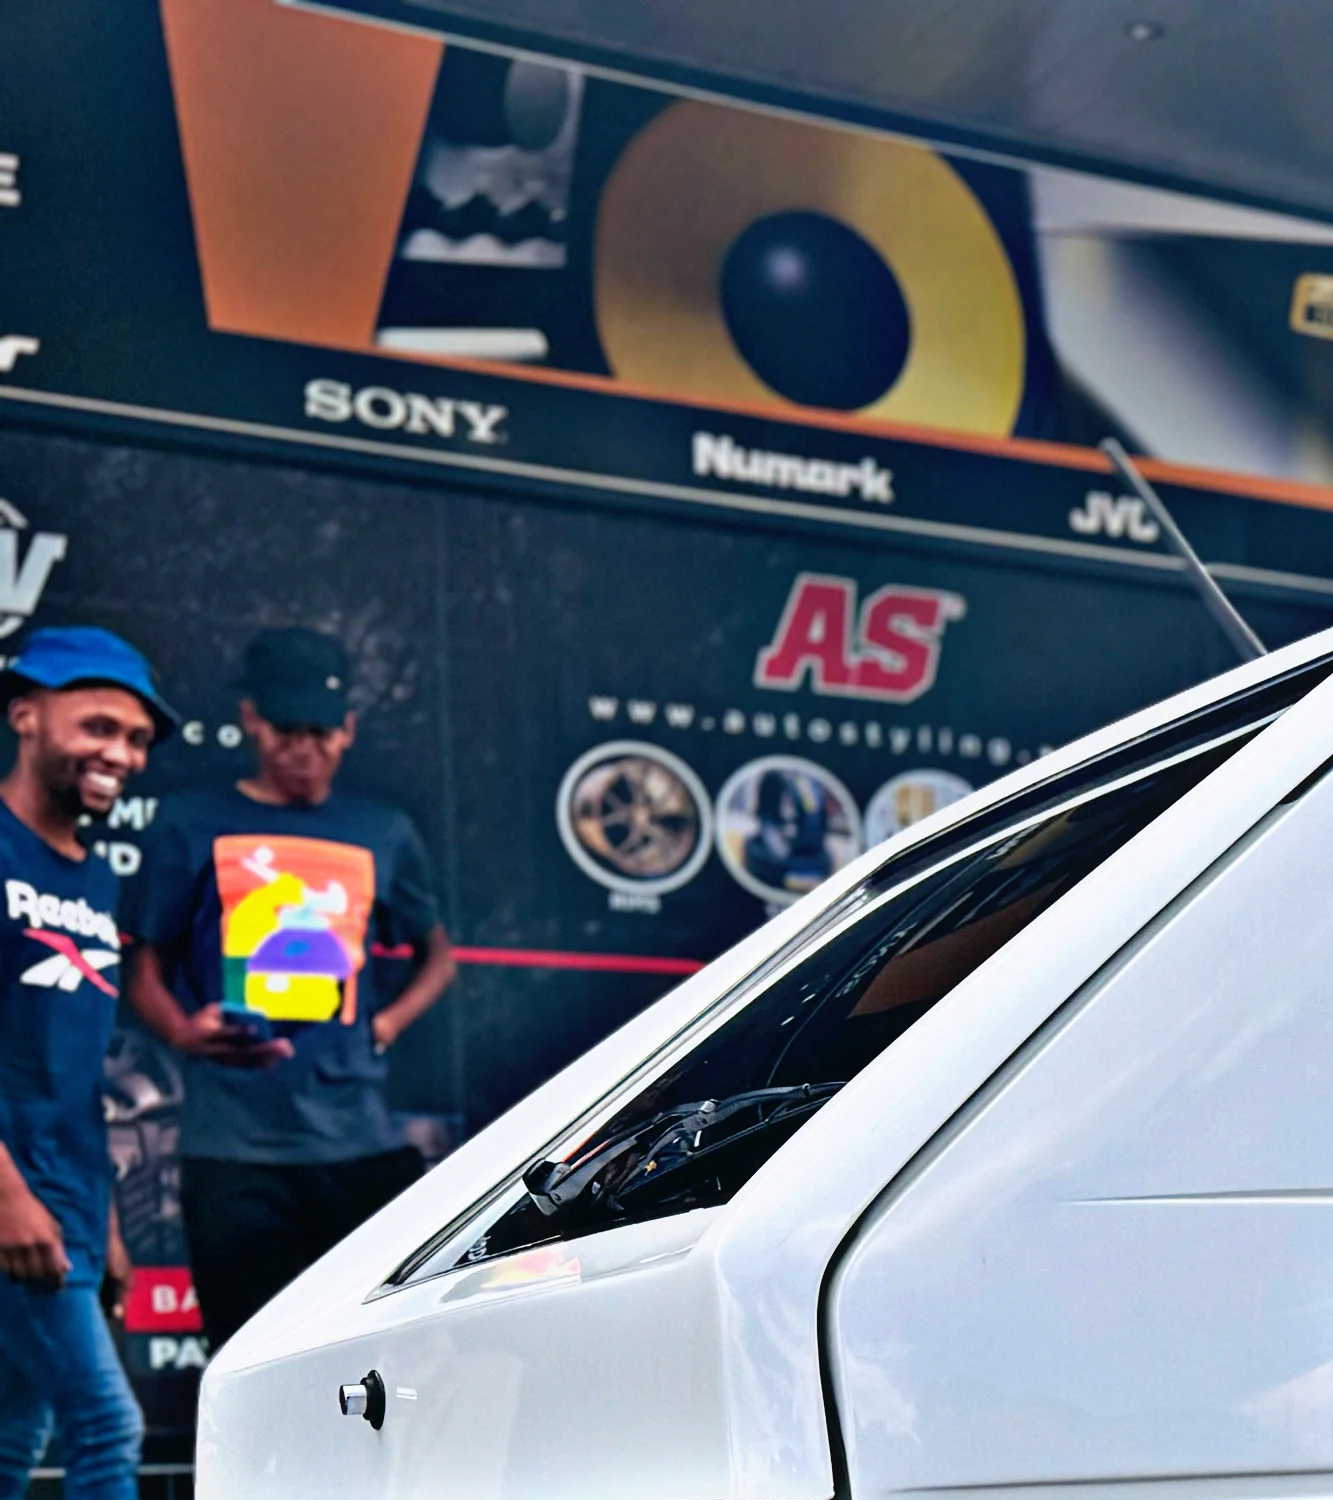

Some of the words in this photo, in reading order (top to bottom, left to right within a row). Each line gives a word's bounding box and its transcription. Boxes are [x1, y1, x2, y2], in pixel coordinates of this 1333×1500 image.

[304, 378, 509, 443] SONY
[692, 430, 894, 504] Numark
[1068, 489, 1160, 544] JVC
[752, 571, 945, 704] AS
